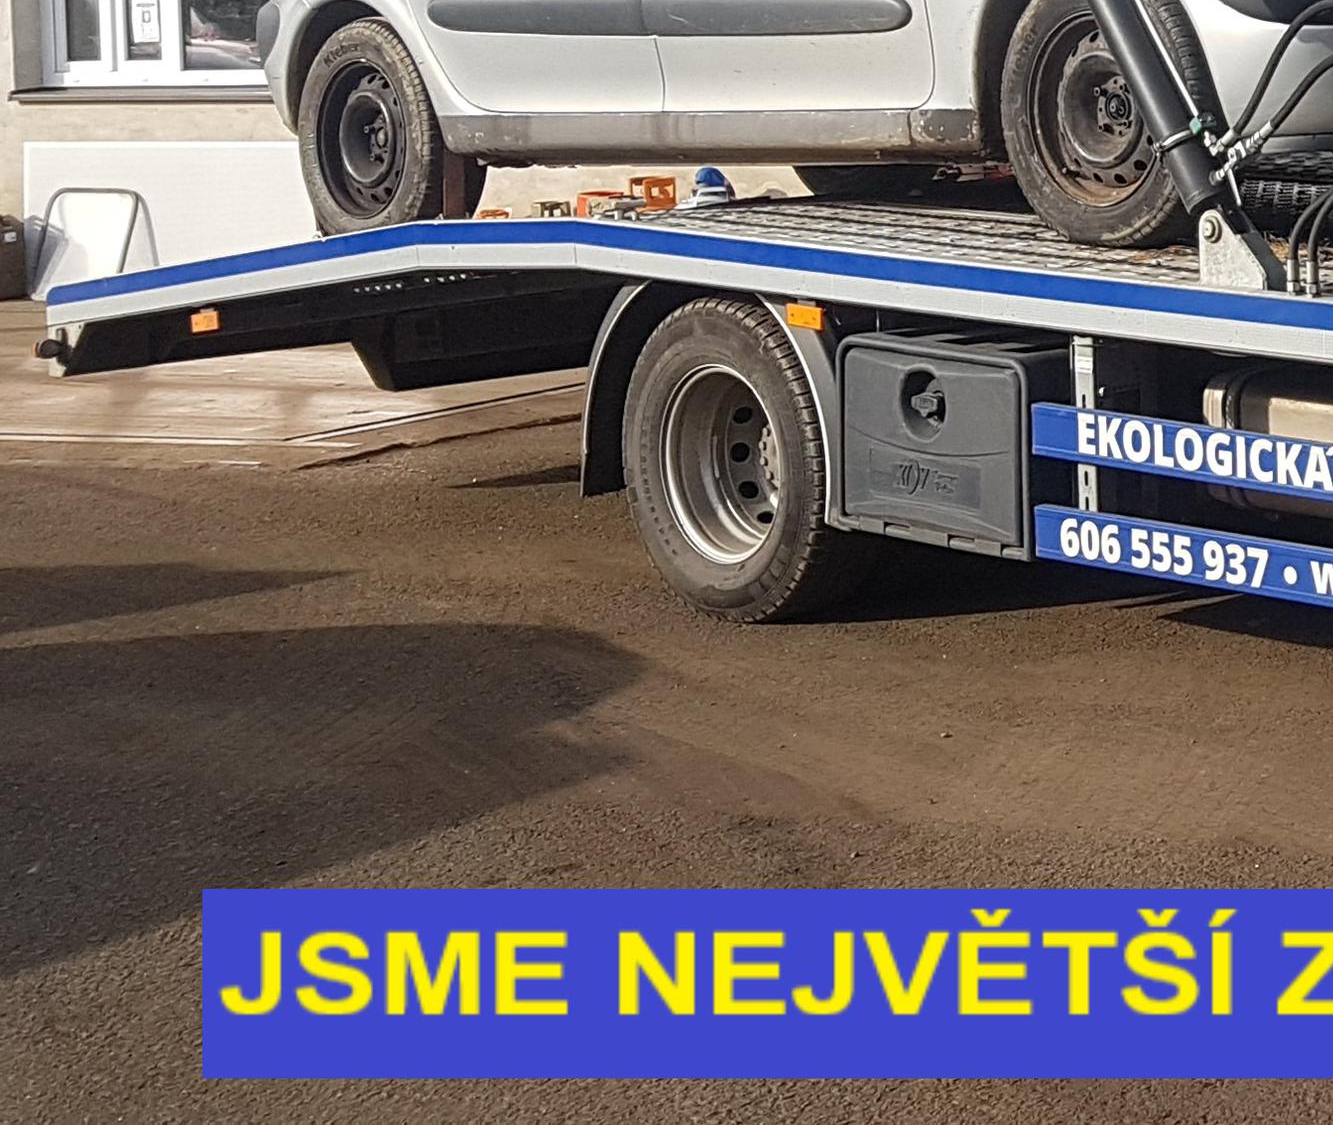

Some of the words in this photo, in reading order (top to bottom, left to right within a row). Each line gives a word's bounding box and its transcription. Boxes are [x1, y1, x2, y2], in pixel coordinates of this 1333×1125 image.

[1059, 518, 1121, 564] 606
[1131, 527, 1193, 576] 555
[1203, 540, 1270, 588] 937
